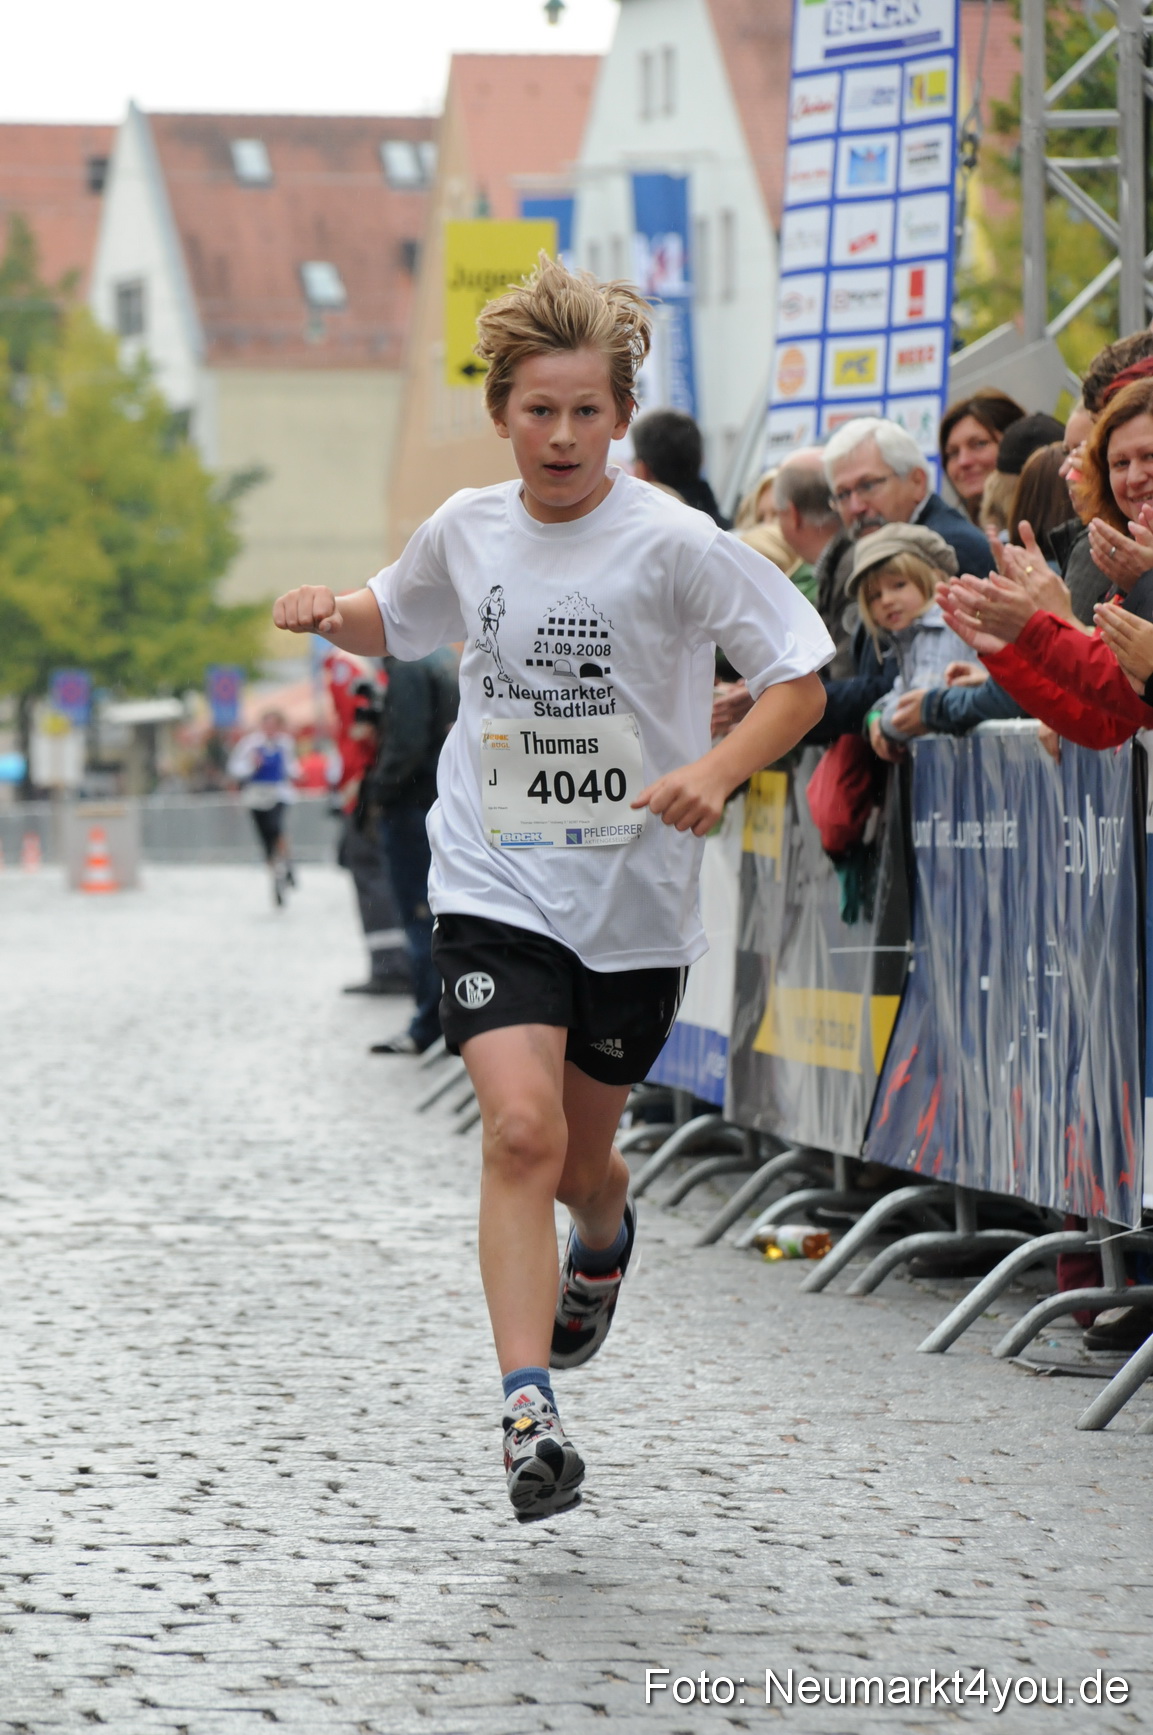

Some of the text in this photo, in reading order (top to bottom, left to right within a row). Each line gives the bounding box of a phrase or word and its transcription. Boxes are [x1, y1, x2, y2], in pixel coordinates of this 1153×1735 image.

[533, 641, 612, 657] 21.09.2008
[482, 675, 614, 701] 9. Neumarkter
[533, 698, 617, 718] Stadtlauf
[520, 731, 599, 755] Thomas
[488, 768, 498, 786] J
[527, 767, 627, 805] 4040
[500, 832, 543, 842] BOCK
[583, 824, 643, 838] PFLEIDERER
[511, 1401, 536, 1412] adidas
